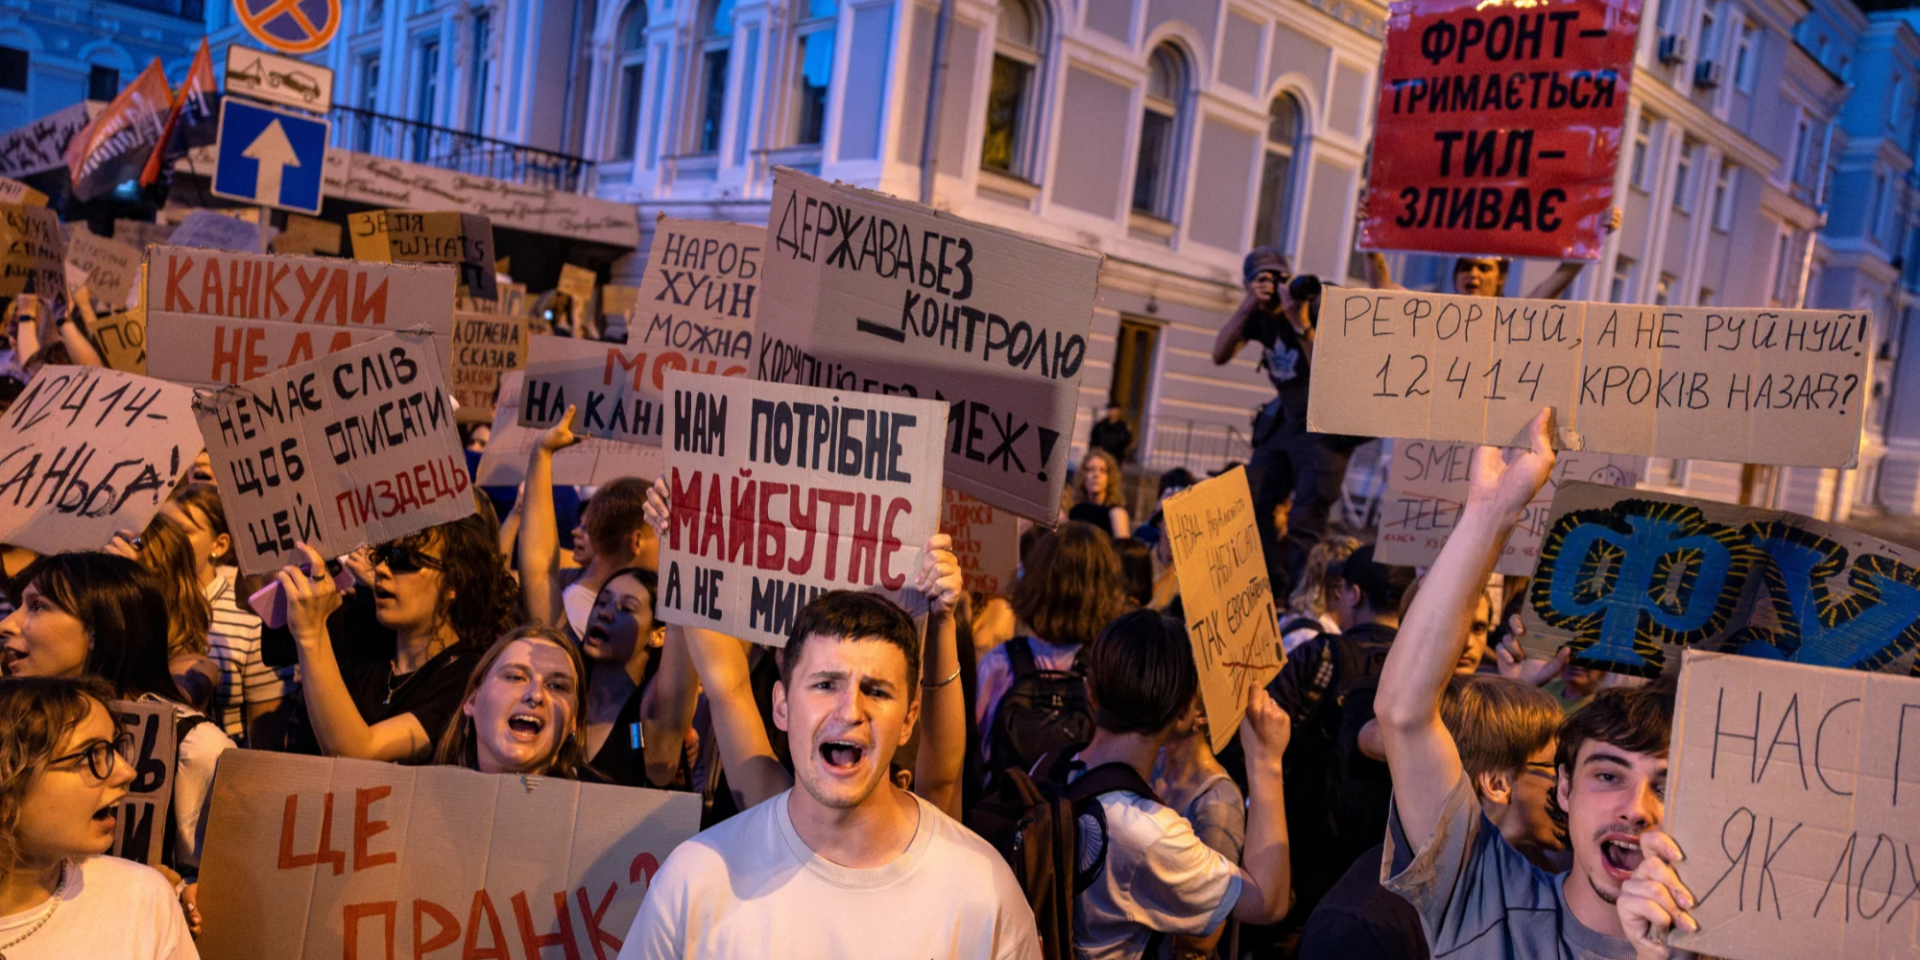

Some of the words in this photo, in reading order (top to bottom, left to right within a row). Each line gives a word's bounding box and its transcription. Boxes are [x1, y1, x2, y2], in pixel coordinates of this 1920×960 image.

[1390, 69, 1618, 115] ТРИМАЄТЬСЯ
[776, 189, 915, 284] ДЕРЖАВА
[918, 230, 974, 300] БЕЗ
[1395, 186, 1567, 233] ЗЛИВАЄ
[164, 254, 391, 327] КАНІКУЛИ
[1343, 296, 1582, 350] РЕФОРМУЙ,
[1597, 311, 1620, 349] А
[1635, 312, 1683, 351] НЕ
[1703, 311, 1869, 358] РУЙНУЙ!
[211, 326, 267, 385] НЕ
[459, 347, 518, 369] СКАЗАВ
[643, 312, 753, 361] МОЖНА
[215, 372, 323, 447] НЕМАЄ
[332, 347, 419, 401] СЛІВ
[1579, 364, 1710, 410] КРОКІВ
[1727, 372, 1859, 416] НАЗАД?
[229, 436, 305, 498] ЩОБ
[324, 386, 449, 466] ОПИСАТИ
[673, 389, 728, 457] НАМ
[749, 396, 918, 484] ПОТРІБНЕ
[247, 492, 323, 557] ЦЕЙ
[335, 455, 469, 532] ПИЗДЕЦЬ
[669, 466, 913, 592] МАЙБУТНЄ
[664, 560, 682, 610] А
[692, 565, 725, 621] НЕ
[749, 575, 829, 637] МИ
[1191, 609, 1227, 672] ТАК
[1711, 687, 1862, 796] НАС
[277, 784, 397, 876] ЦЕ
[1697, 806, 1803, 921] ЯК
